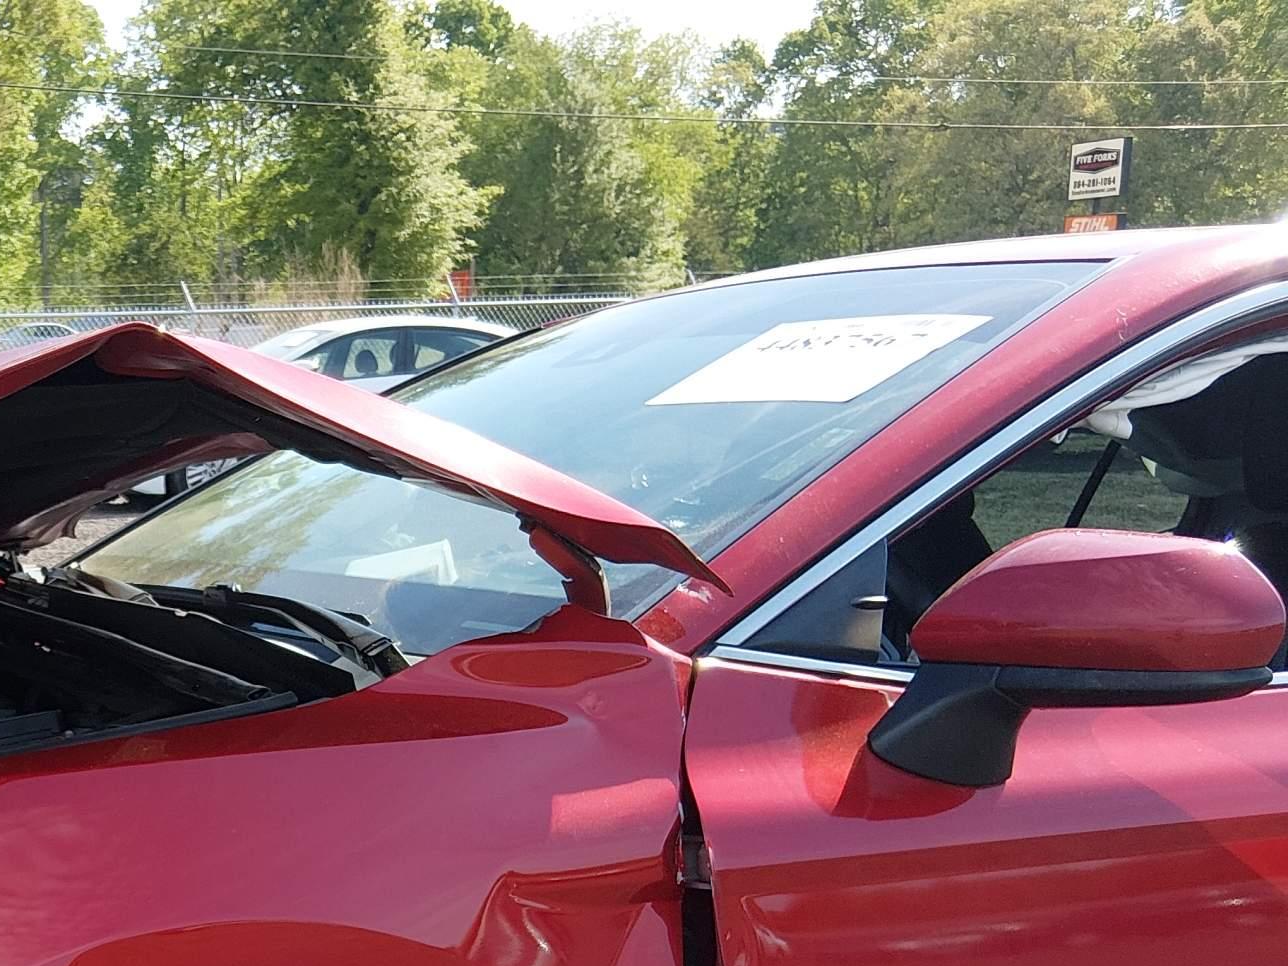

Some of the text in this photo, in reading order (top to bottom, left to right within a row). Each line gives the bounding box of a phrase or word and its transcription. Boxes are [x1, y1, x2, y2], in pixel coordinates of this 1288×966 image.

[1076, 152, 1117, 165] FIVE FORKS
[1070, 217, 1109, 232] STIHL
